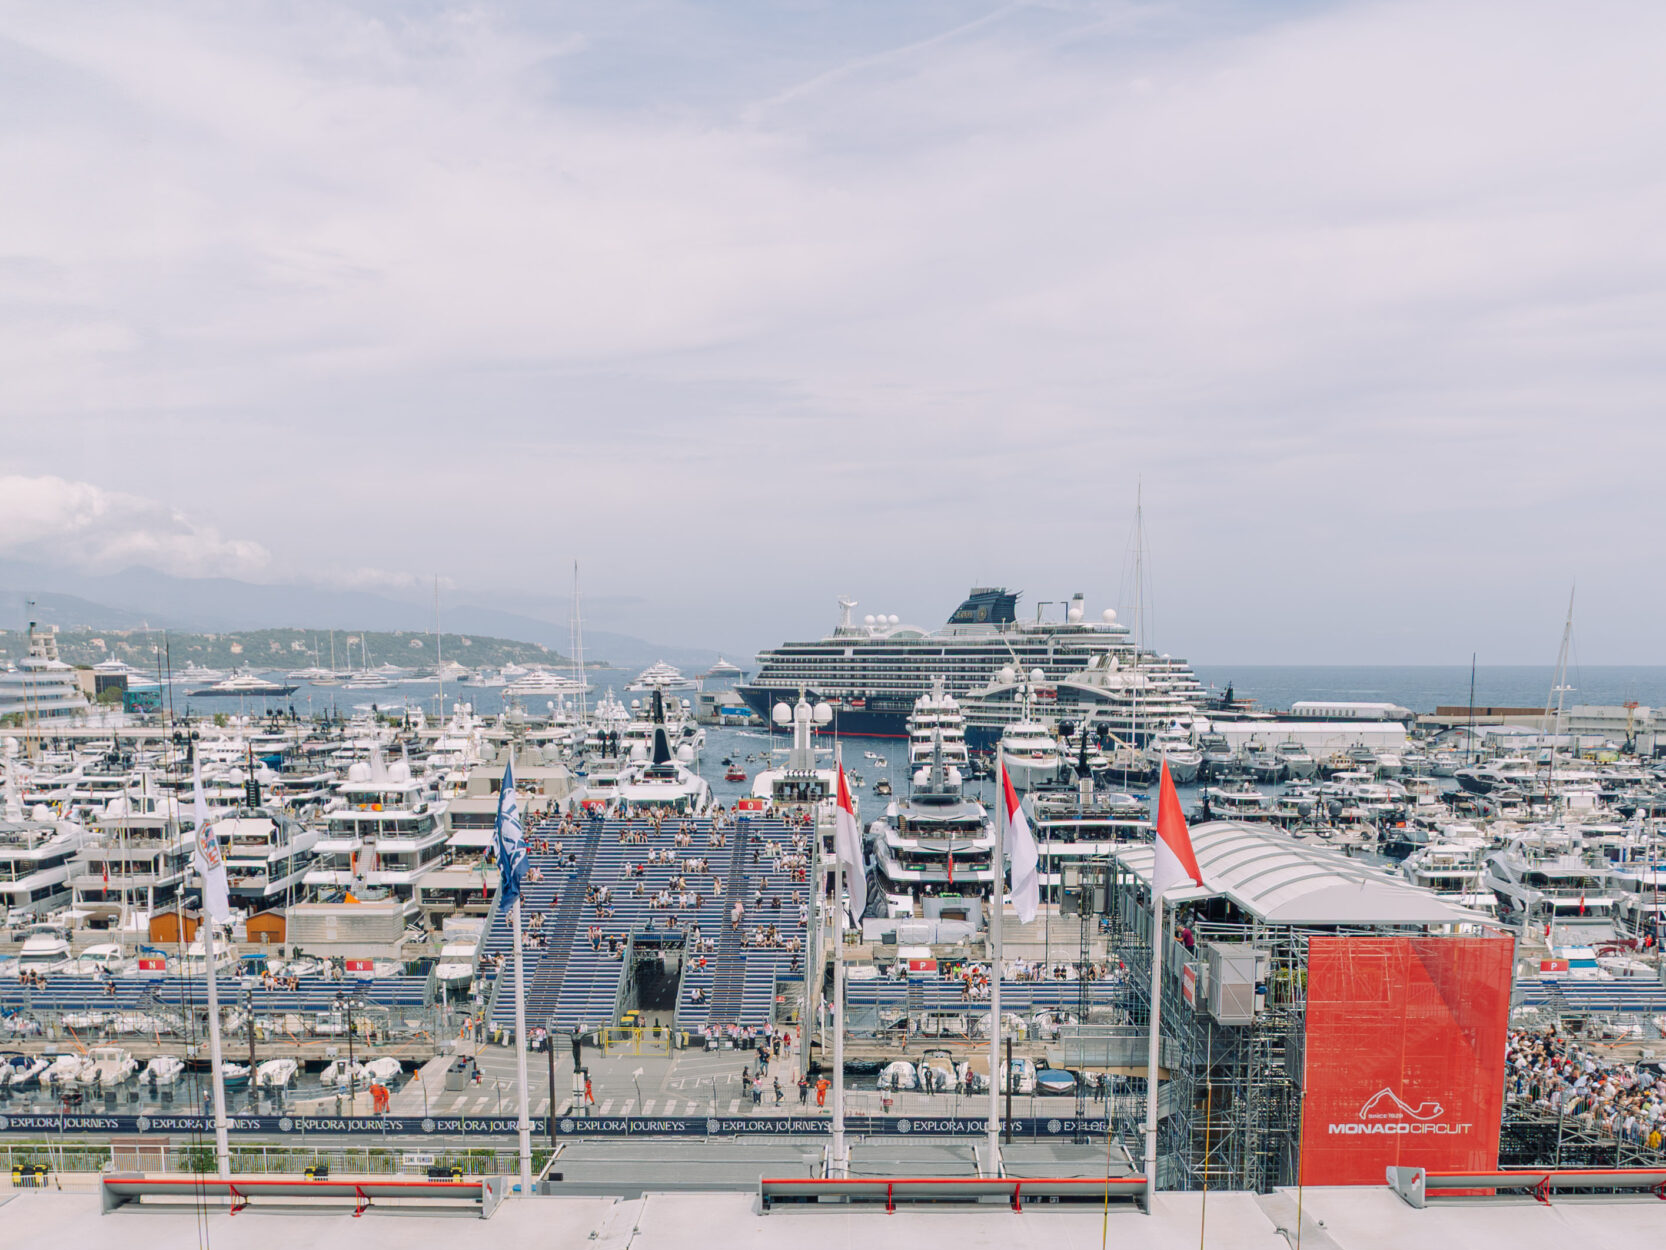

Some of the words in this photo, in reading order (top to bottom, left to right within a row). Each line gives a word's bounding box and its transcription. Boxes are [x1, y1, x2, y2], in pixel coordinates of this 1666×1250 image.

[149, 961, 156, 969] N
[356, 961, 364, 970] N
[919, 962, 926, 970] P
[1550, 962, 1558, 971] P
[11, 1118, 61, 1128] EXPLORA
[63, 1118, 119, 1130] JOURNEYS
[152, 1119, 202, 1129] EXPLORA
[295, 1119, 346, 1130] EXPLORA
[347, 1119, 403, 1132] JOURNEYS
[437, 1120, 488, 1131] EXPLORA
[576, 1121, 627, 1131] EXPLORA
[629, 1121, 686, 1133] JOURNEYS
[722, 1121, 773, 1131] EXPLORA
[775, 1121, 831, 1133] JOURNEYS
[913, 1121, 965, 1131] EXPLORA
